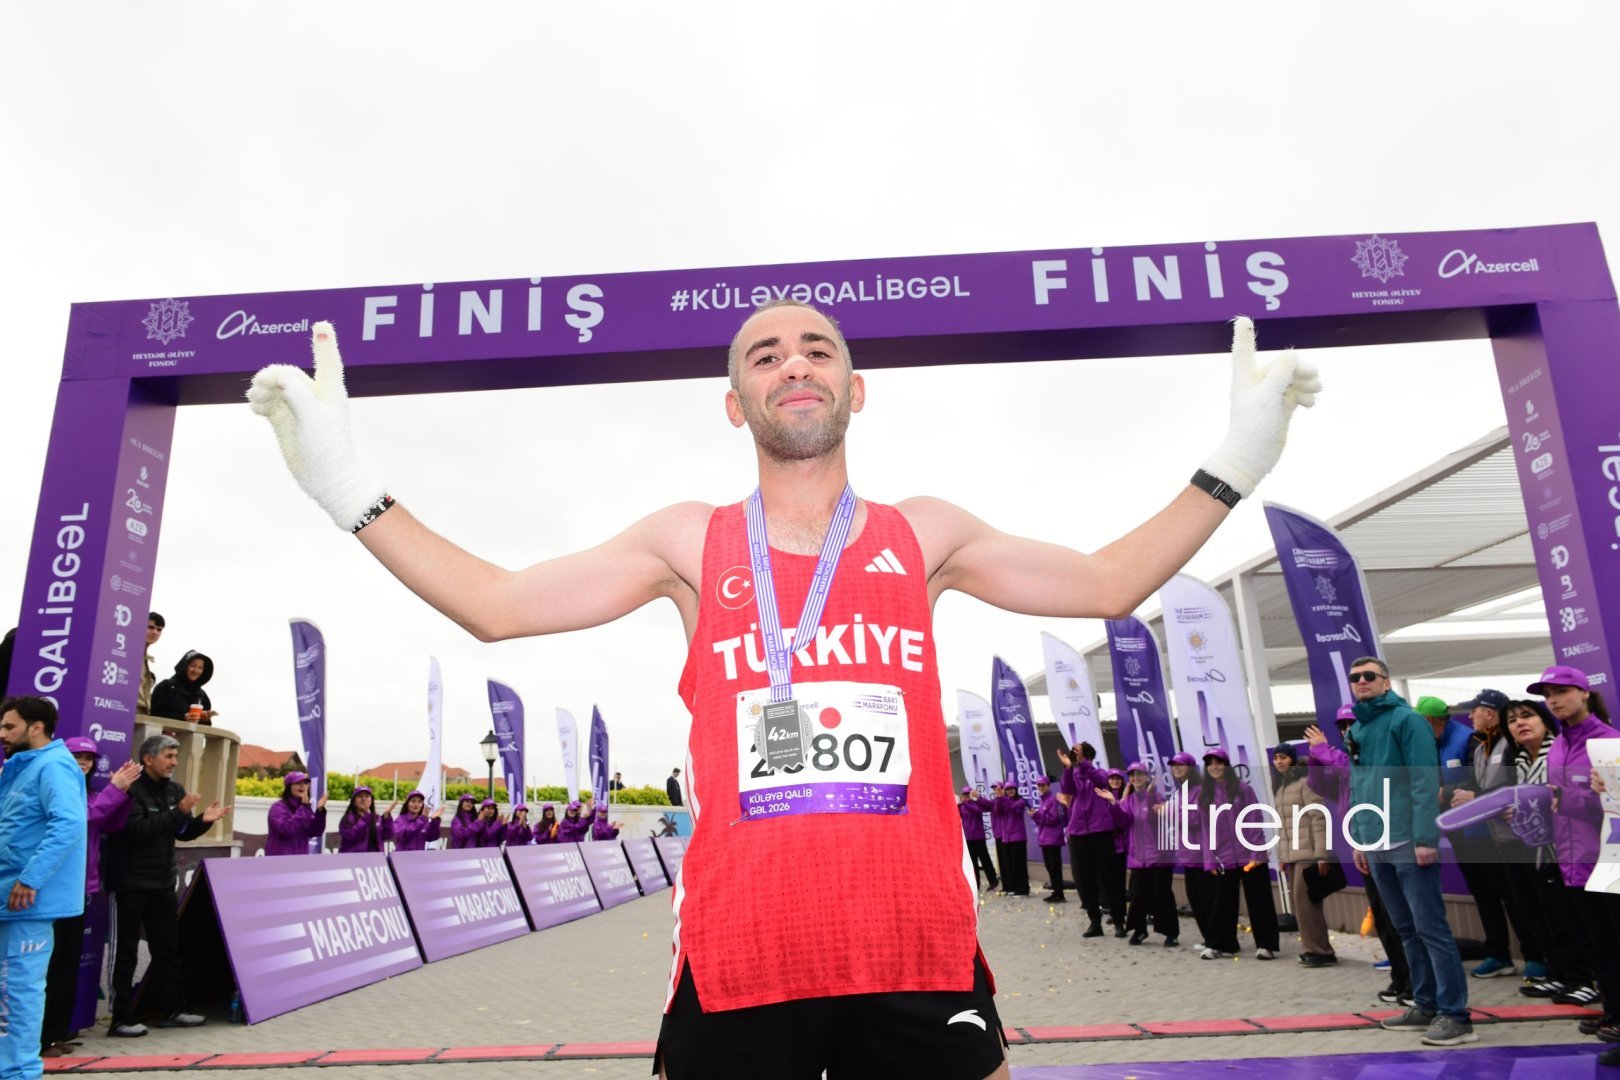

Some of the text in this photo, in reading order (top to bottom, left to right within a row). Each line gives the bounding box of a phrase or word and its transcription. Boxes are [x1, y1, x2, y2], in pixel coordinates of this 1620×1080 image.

[1032, 240, 1289, 311] FİNİŞ
[1475, 258, 1540, 274] Azercell
[362, 277, 604, 343] FİNİŞ
[670, 273, 970, 311] #KÜLƏYƏQALİBGƏL
[249, 319, 308, 335] Azercell
[750, 733, 895, 778] 2807
[749, 803, 790, 815] GƏL 2026
[784, 788, 812, 799] QALİB
[354, 865, 397, 901] BAKI
[480, 857, 509, 883] BAKI
[453, 888, 521, 925] MARAFONU
[307, 905, 411, 960] MARAFONU
